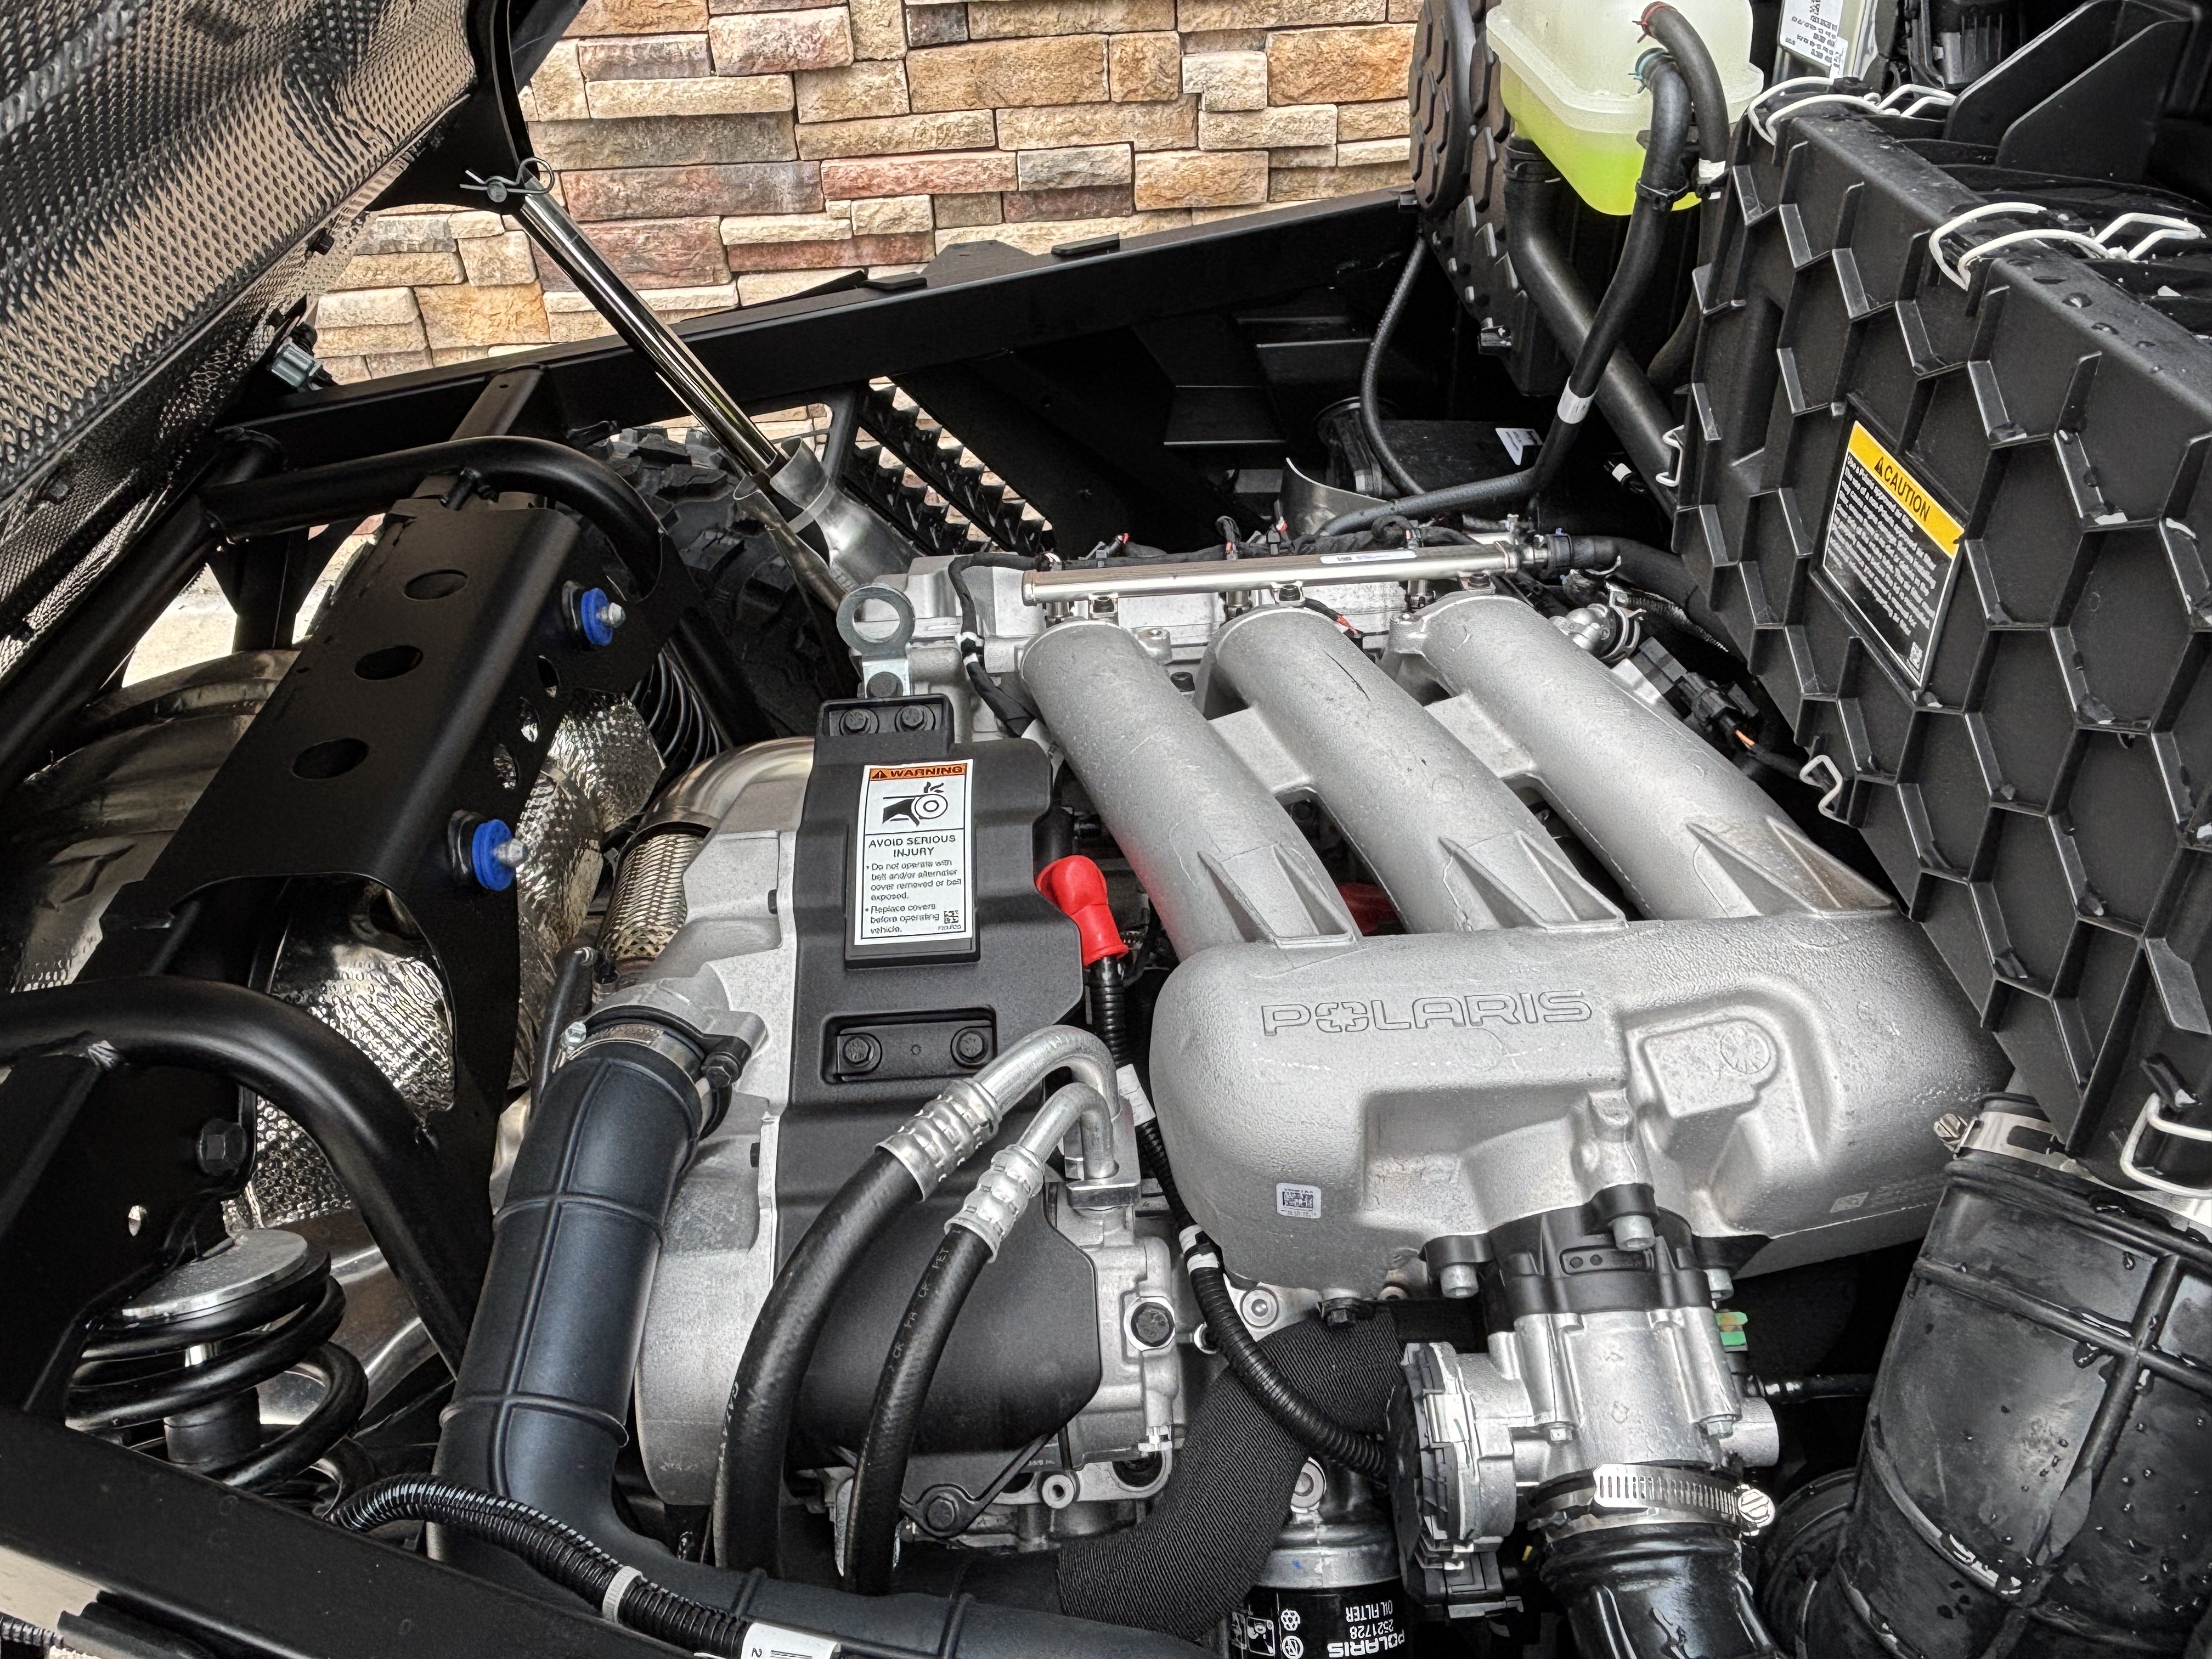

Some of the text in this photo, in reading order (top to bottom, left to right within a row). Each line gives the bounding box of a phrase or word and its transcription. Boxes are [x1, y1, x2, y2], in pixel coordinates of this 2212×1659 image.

[1884, 464, 1931, 522] CAUTION
[890, 765, 963, 777] WARNING
[868, 834, 956, 849] AVOID SERIOUS
[894, 847, 934, 857] INJURY
[1261, 989, 1592, 1036] POLARIS
[1346, 1599, 1393, 1622] OIL FILTER
[1349, 1619, 1393, 1640] 2521728
[1327, 1628, 1405, 1658] POLARIS
